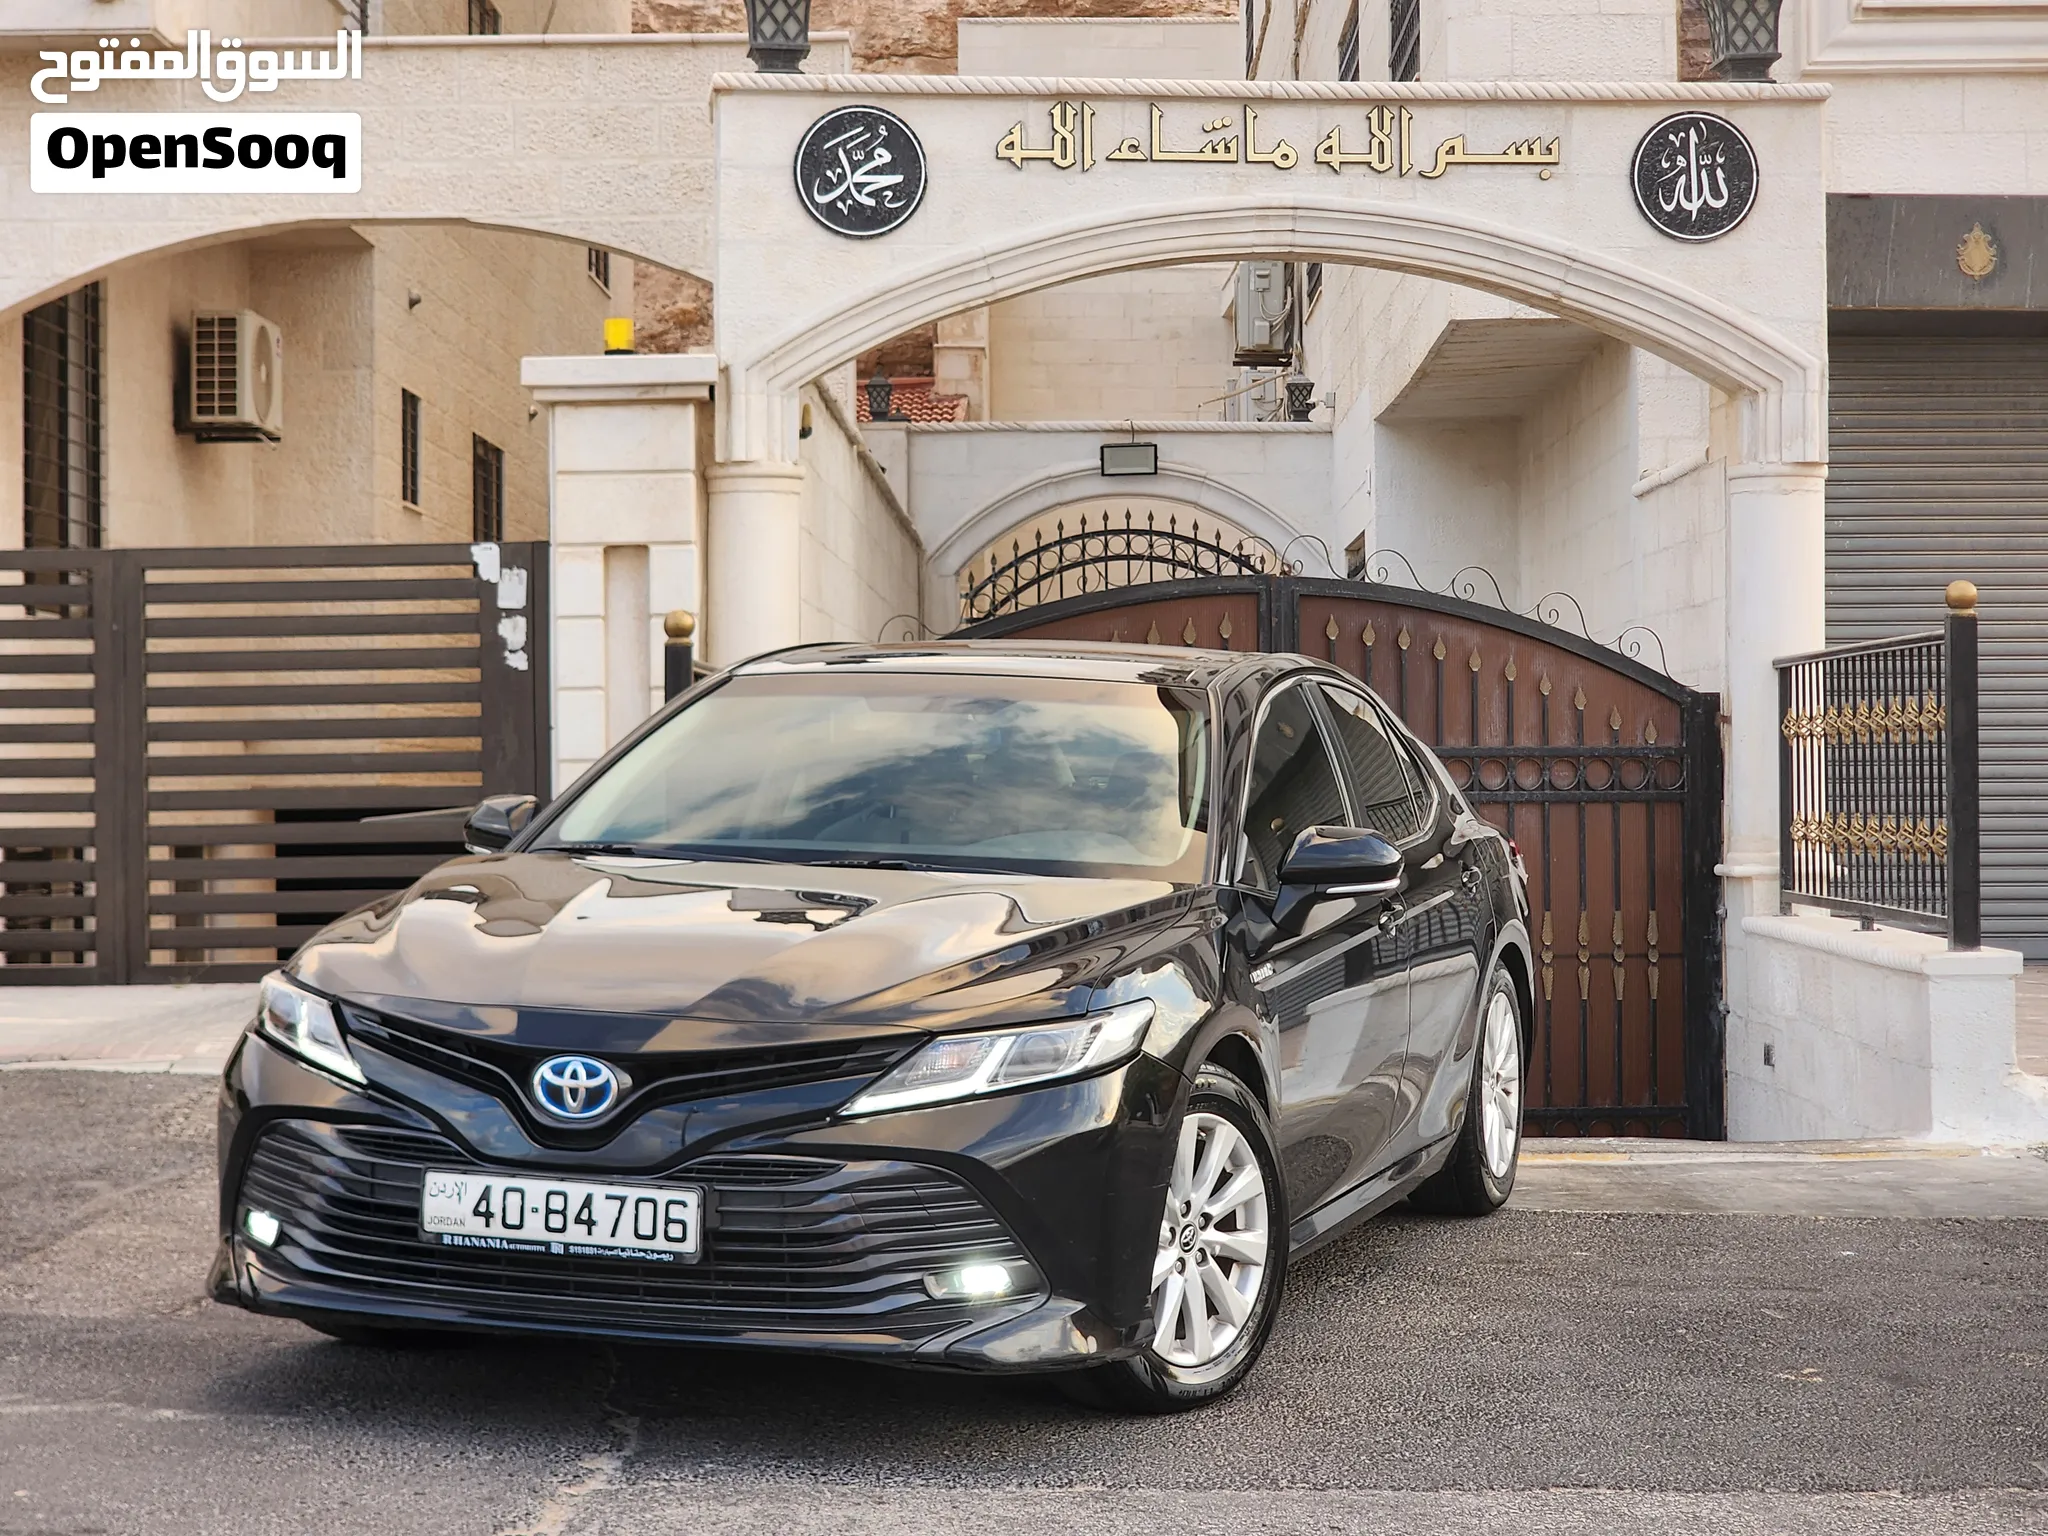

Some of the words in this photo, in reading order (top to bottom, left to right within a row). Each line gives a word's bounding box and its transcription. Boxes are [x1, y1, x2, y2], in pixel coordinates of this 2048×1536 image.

[995, 100, 1096, 173] الله
[1314, 104, 1414, 177] الله
[1419, 132, 1560, 181] بسم
[427, 1215, 466, 1228] JORDAN
